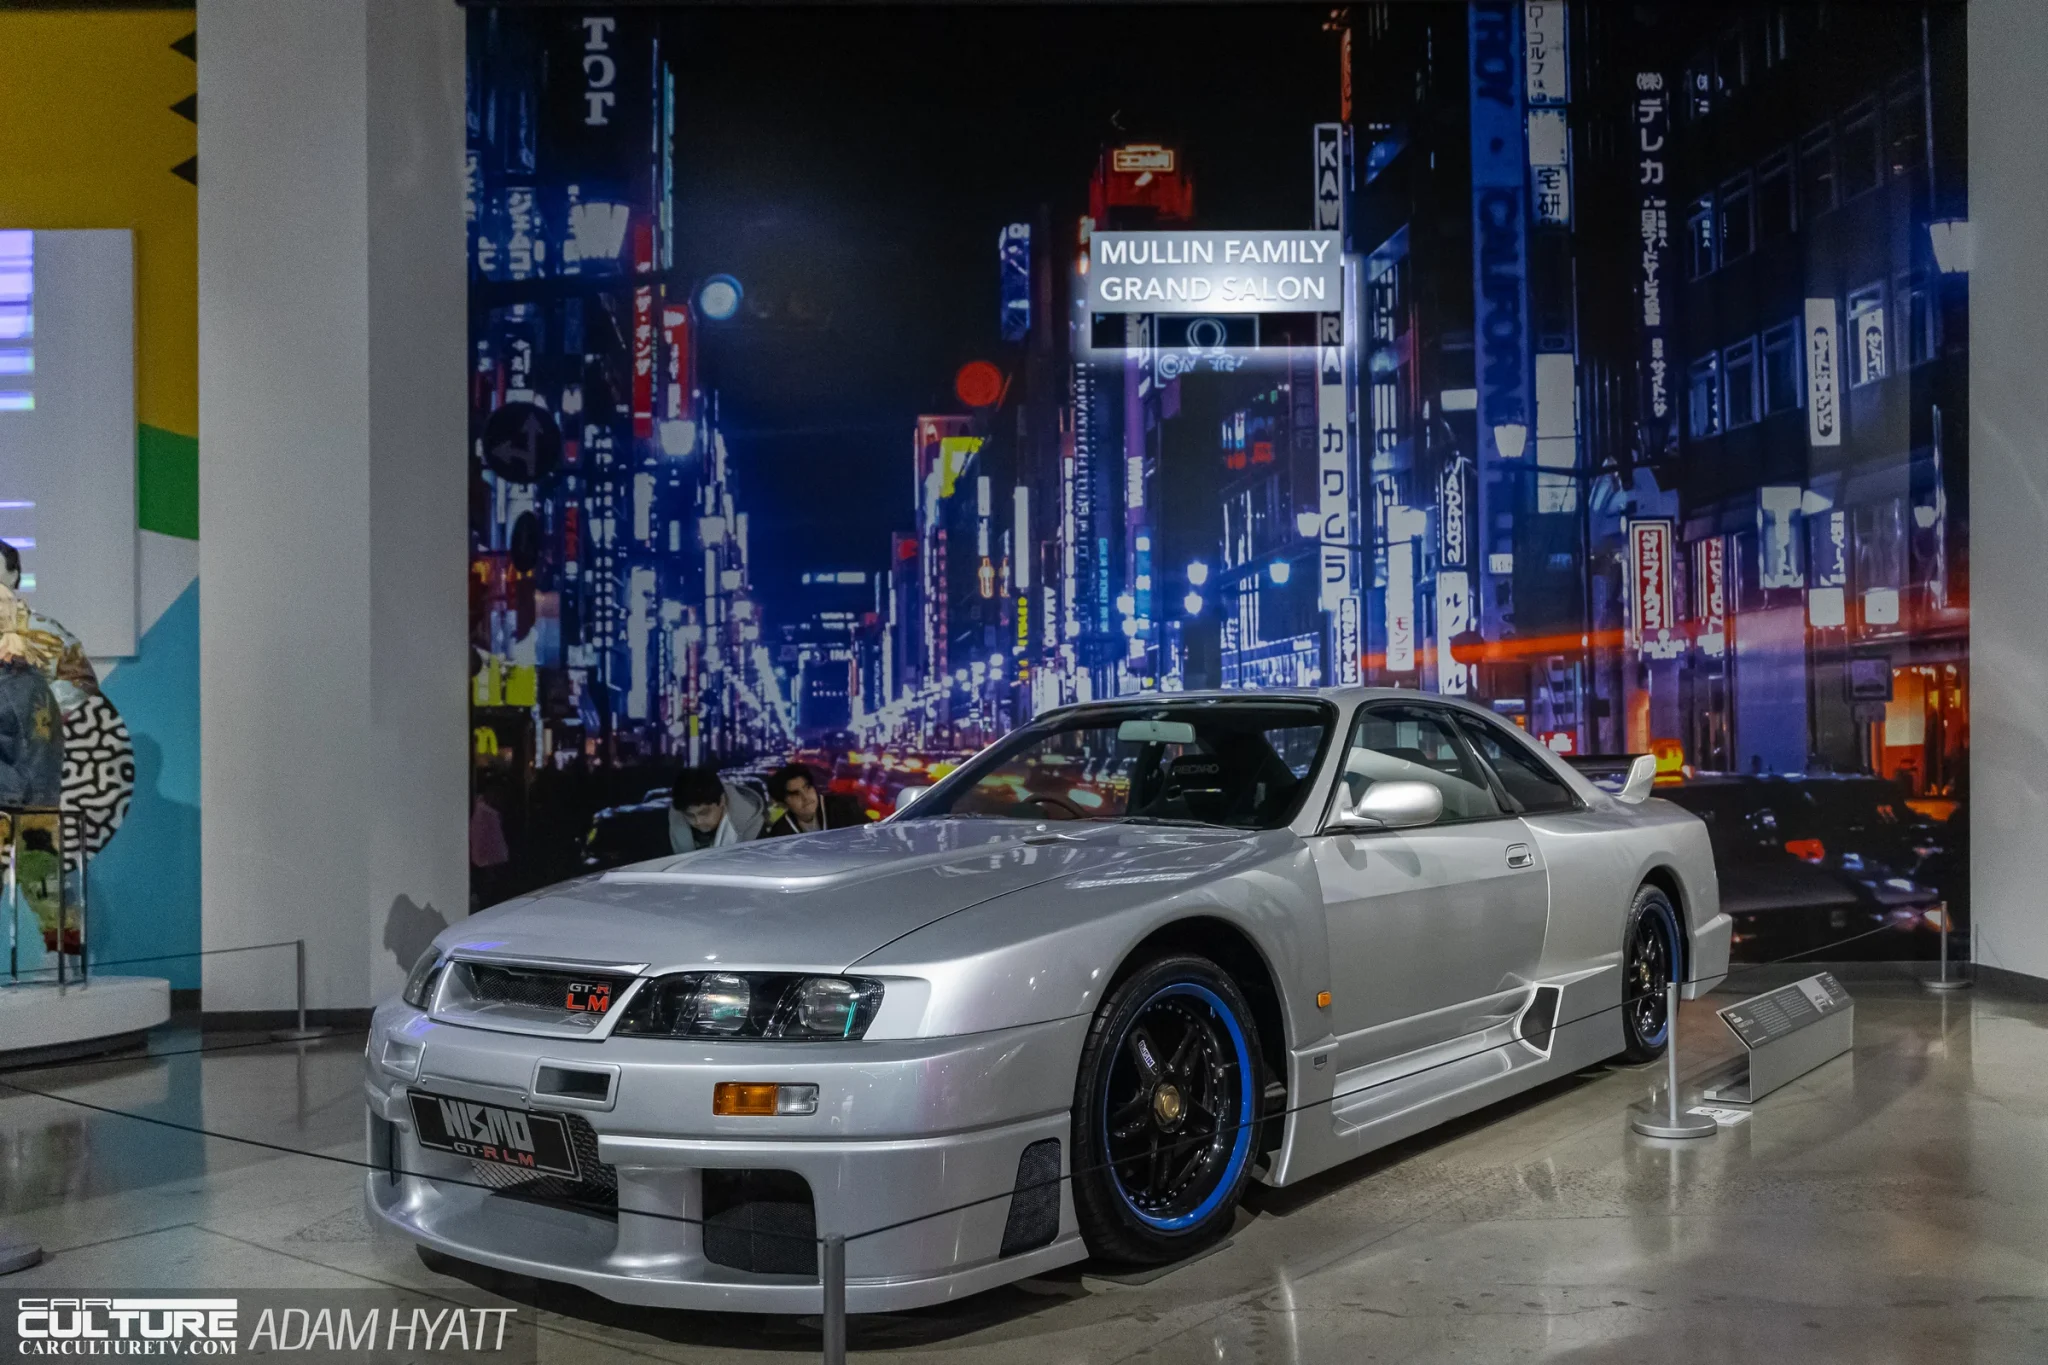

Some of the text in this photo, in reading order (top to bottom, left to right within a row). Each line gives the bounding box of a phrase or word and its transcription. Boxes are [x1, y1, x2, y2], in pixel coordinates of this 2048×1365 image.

[1100, 240, 1330, 265] MULLIN FAMILY
[1100, 276, 1325, 301] GRAND SALON
[569, 983, 609, 995] GT-R
[567, 993, 608, 1012] LM
[437, 1098, 536, 1153] NISMO
[453, 1142, 535, 1168] GT-R LM
